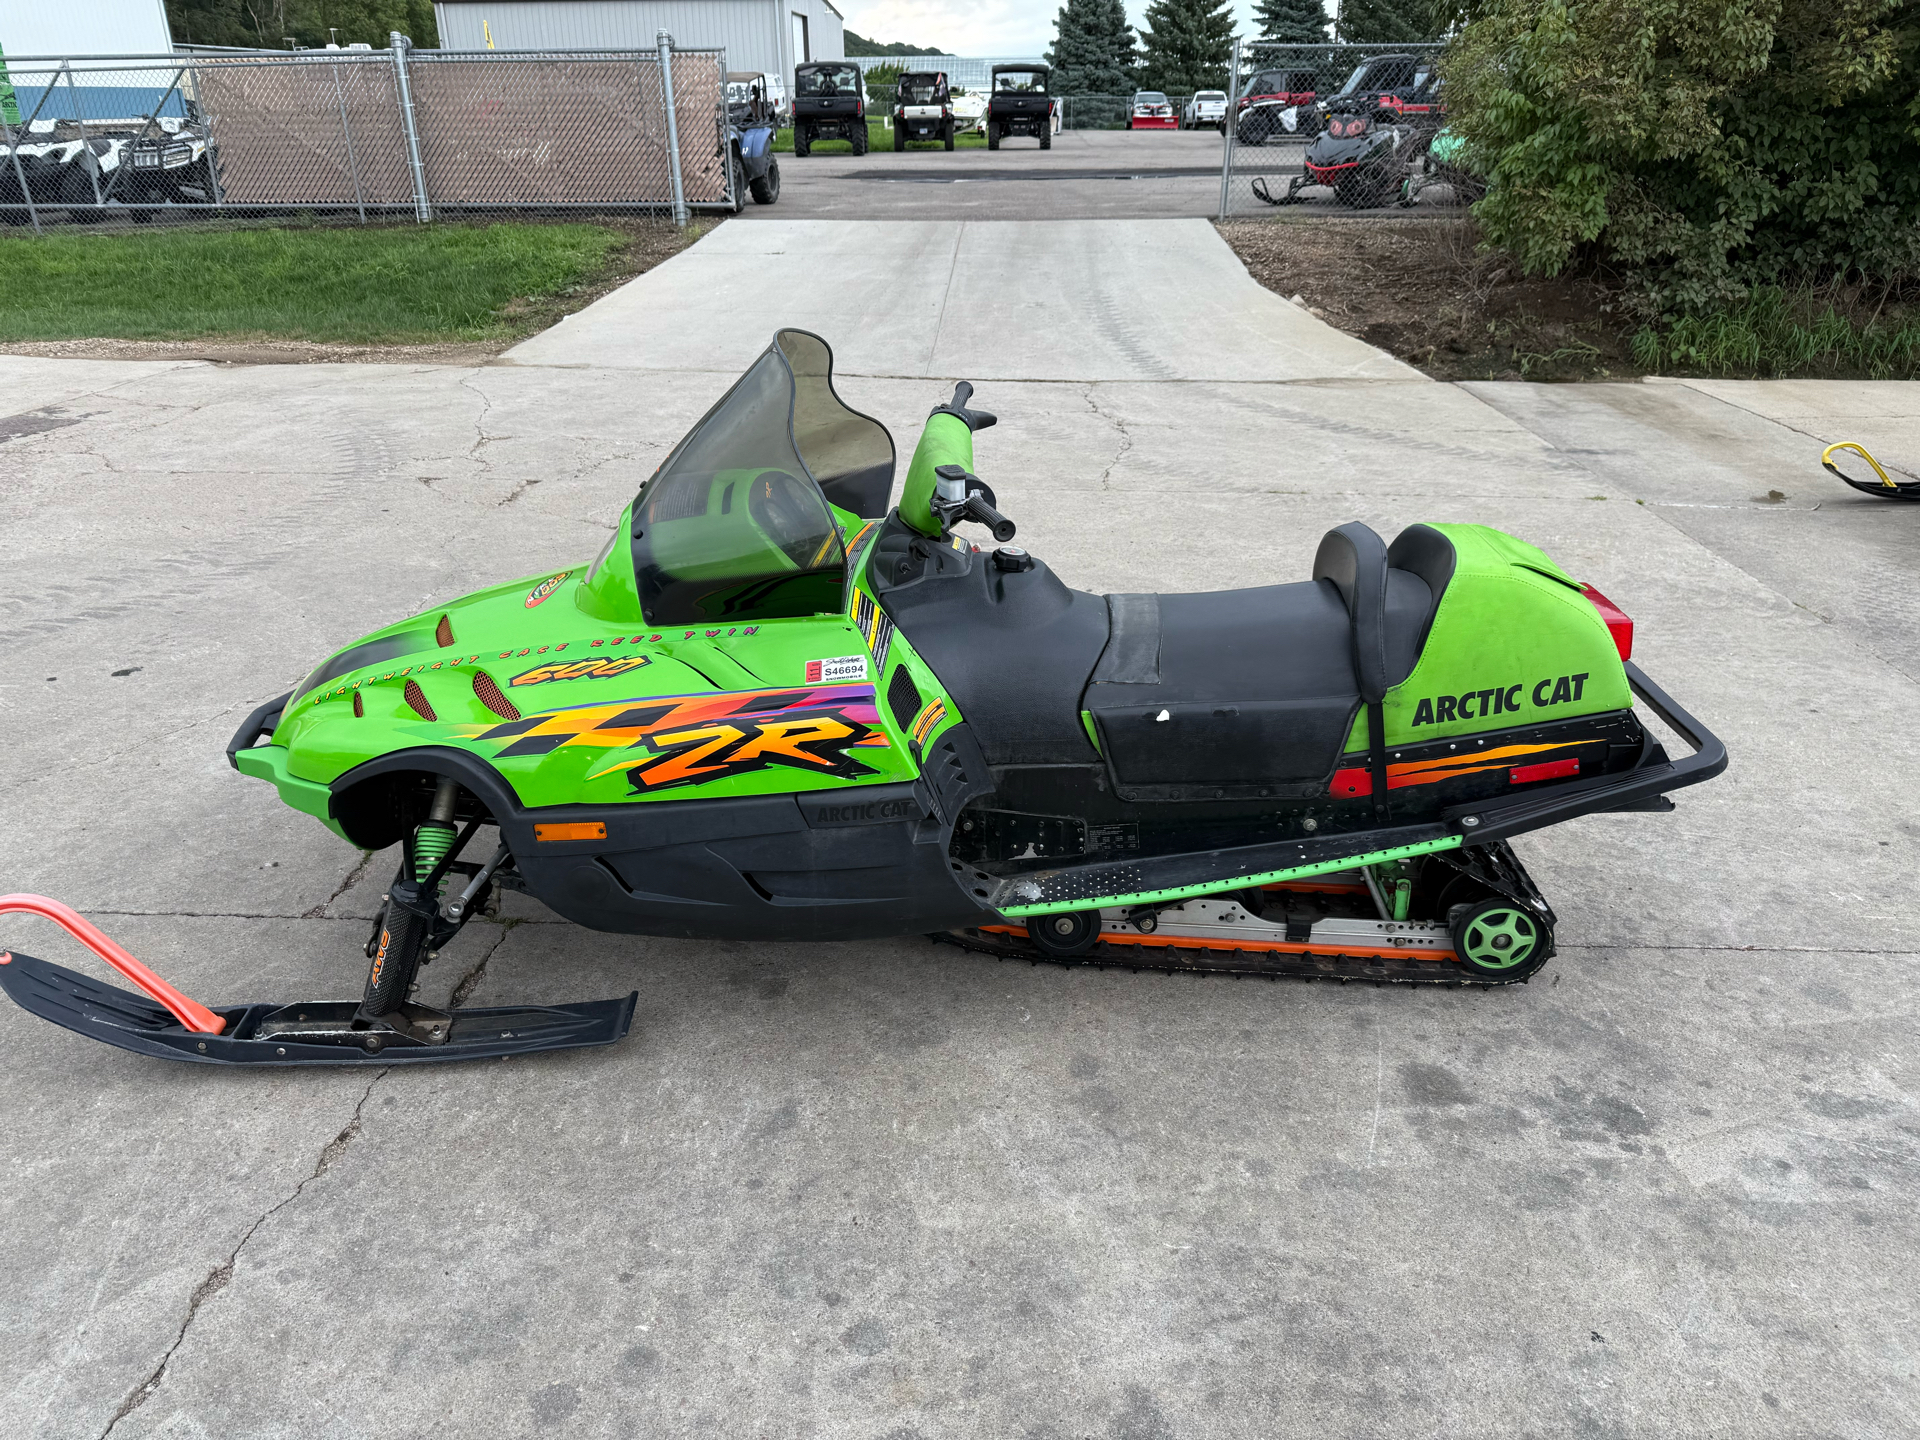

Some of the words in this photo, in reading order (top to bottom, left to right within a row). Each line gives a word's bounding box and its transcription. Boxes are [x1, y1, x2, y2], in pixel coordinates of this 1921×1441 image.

[314, 655, 479, 706] LIGHTWEIGHT
[498, 643, 569, 660] CASE
[590, 634, 663, 648] REED
[684, 625, 760, 640] TWIN
[511, 656, 652, 687] 600
[825, 665, 864, 676] S46694
[1411, 683, 1523, 727] ARCTIC
[1532, 672, 1589, 707] CAT
[630, 711, 872, 792] ZR
[817, 803, 876, 822] ARCTIC
[880, 801, 911, 818] CAT
